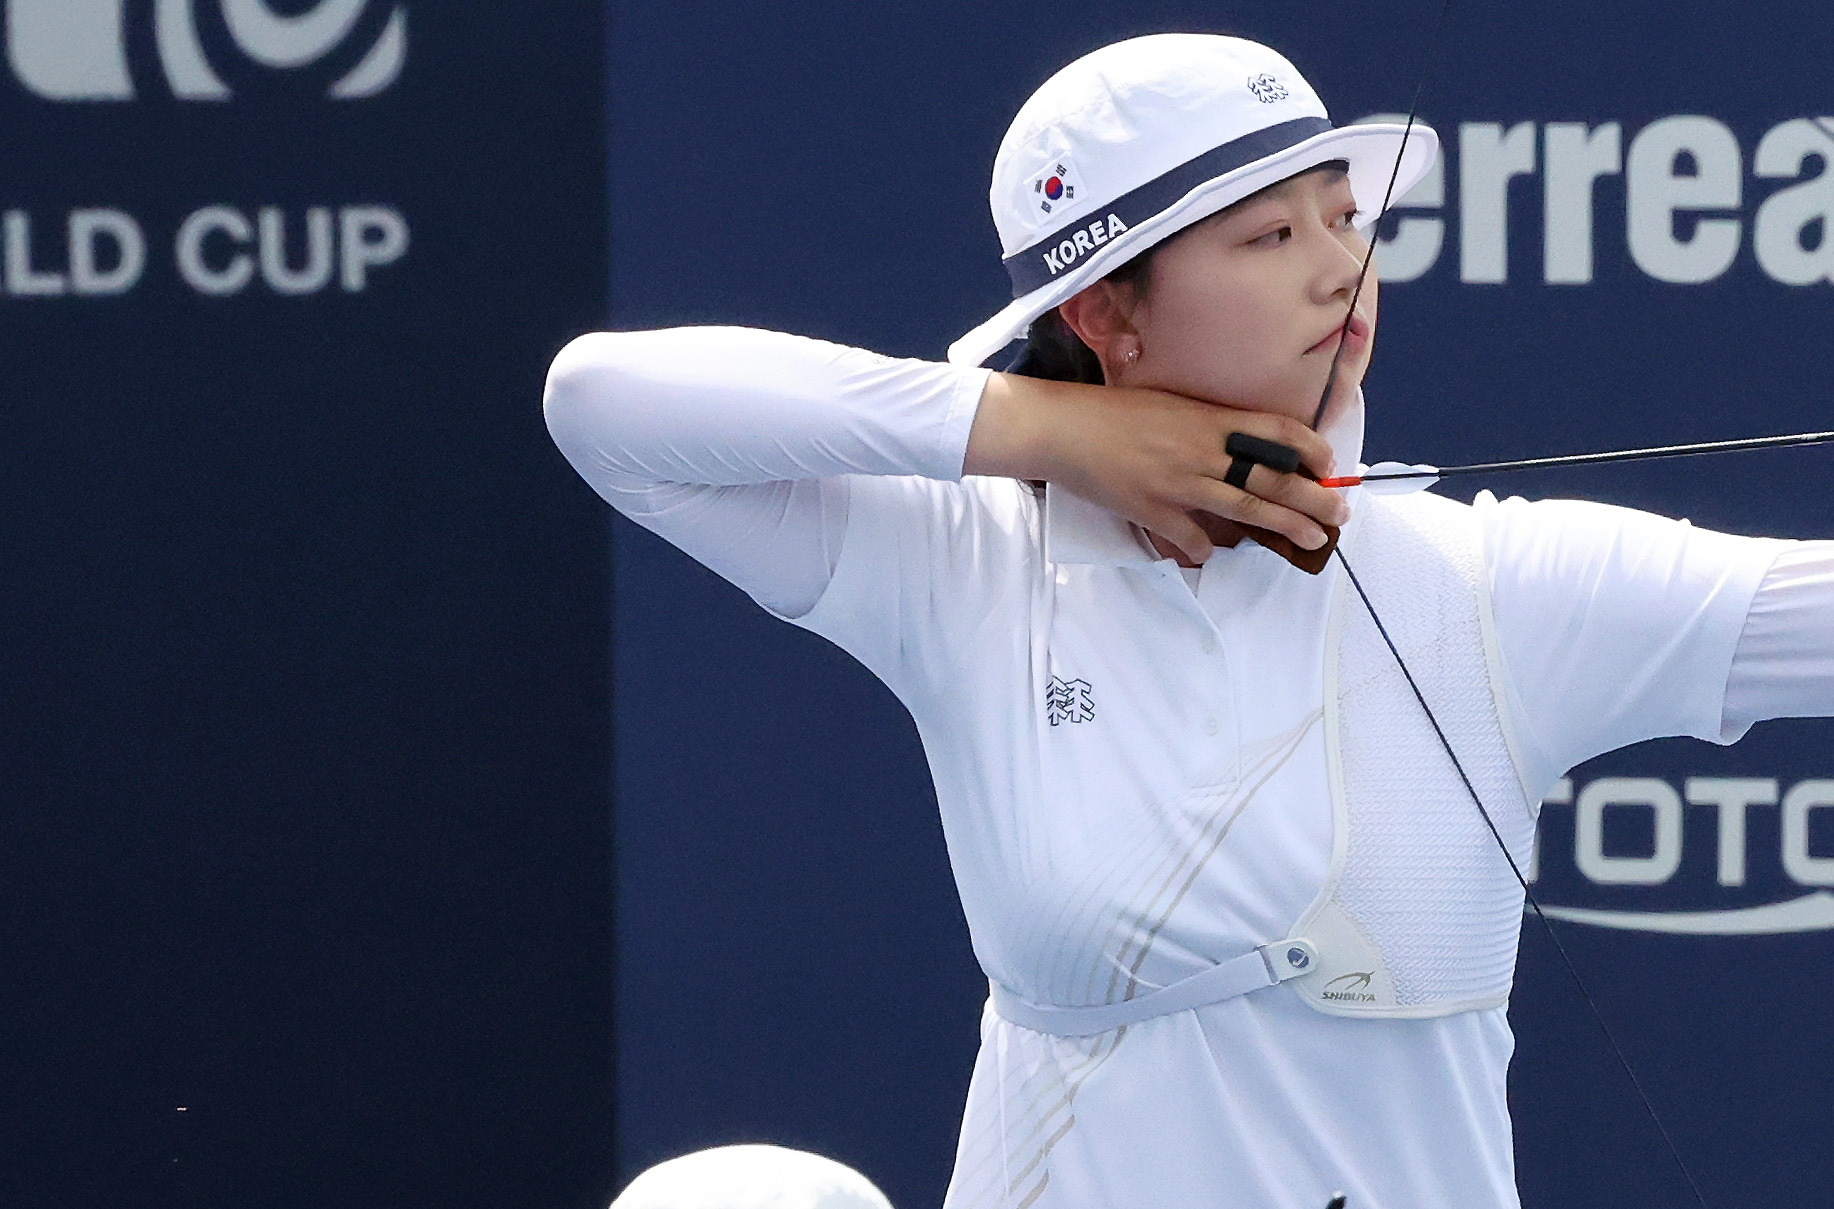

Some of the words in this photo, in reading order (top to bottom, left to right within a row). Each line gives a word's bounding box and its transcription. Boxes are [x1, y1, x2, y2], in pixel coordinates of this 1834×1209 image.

[0, 207, 148, 296] LD
[175, 205, 411, 297] CUP
[1043, 213, 1128, 275] KOREA
[1321, 991, 1377, 1002] SHIBUYA
